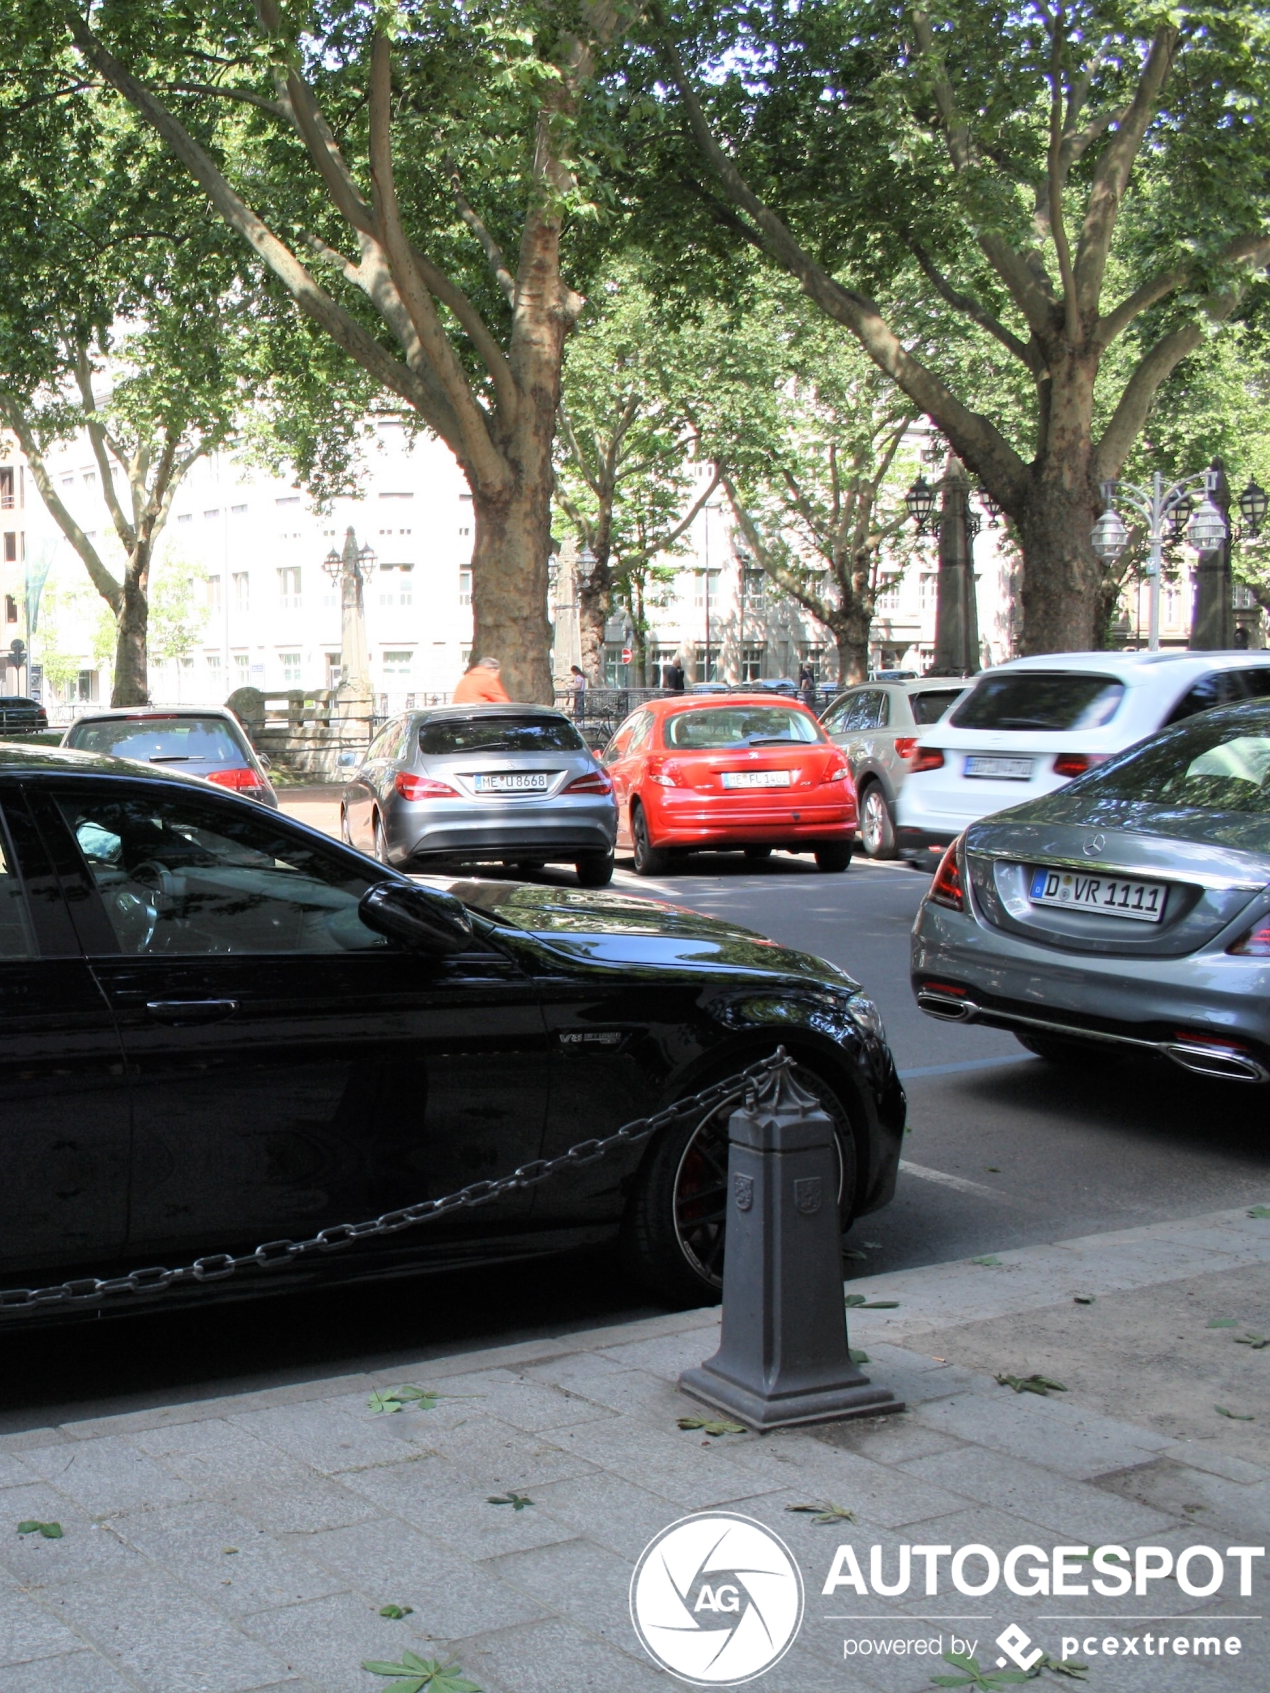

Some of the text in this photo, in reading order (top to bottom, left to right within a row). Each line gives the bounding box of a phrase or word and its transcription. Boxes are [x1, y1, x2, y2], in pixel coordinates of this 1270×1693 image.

[482, 775, 545, 788] ME U 8668
[749, 774, 762, 784] FL
[1044, 873, 1060, 897] D
[1074, 877, 1101, 903] VR
[1104, 882, 1160, 913] 1111
[559, 1032, 583, 1043] V8
